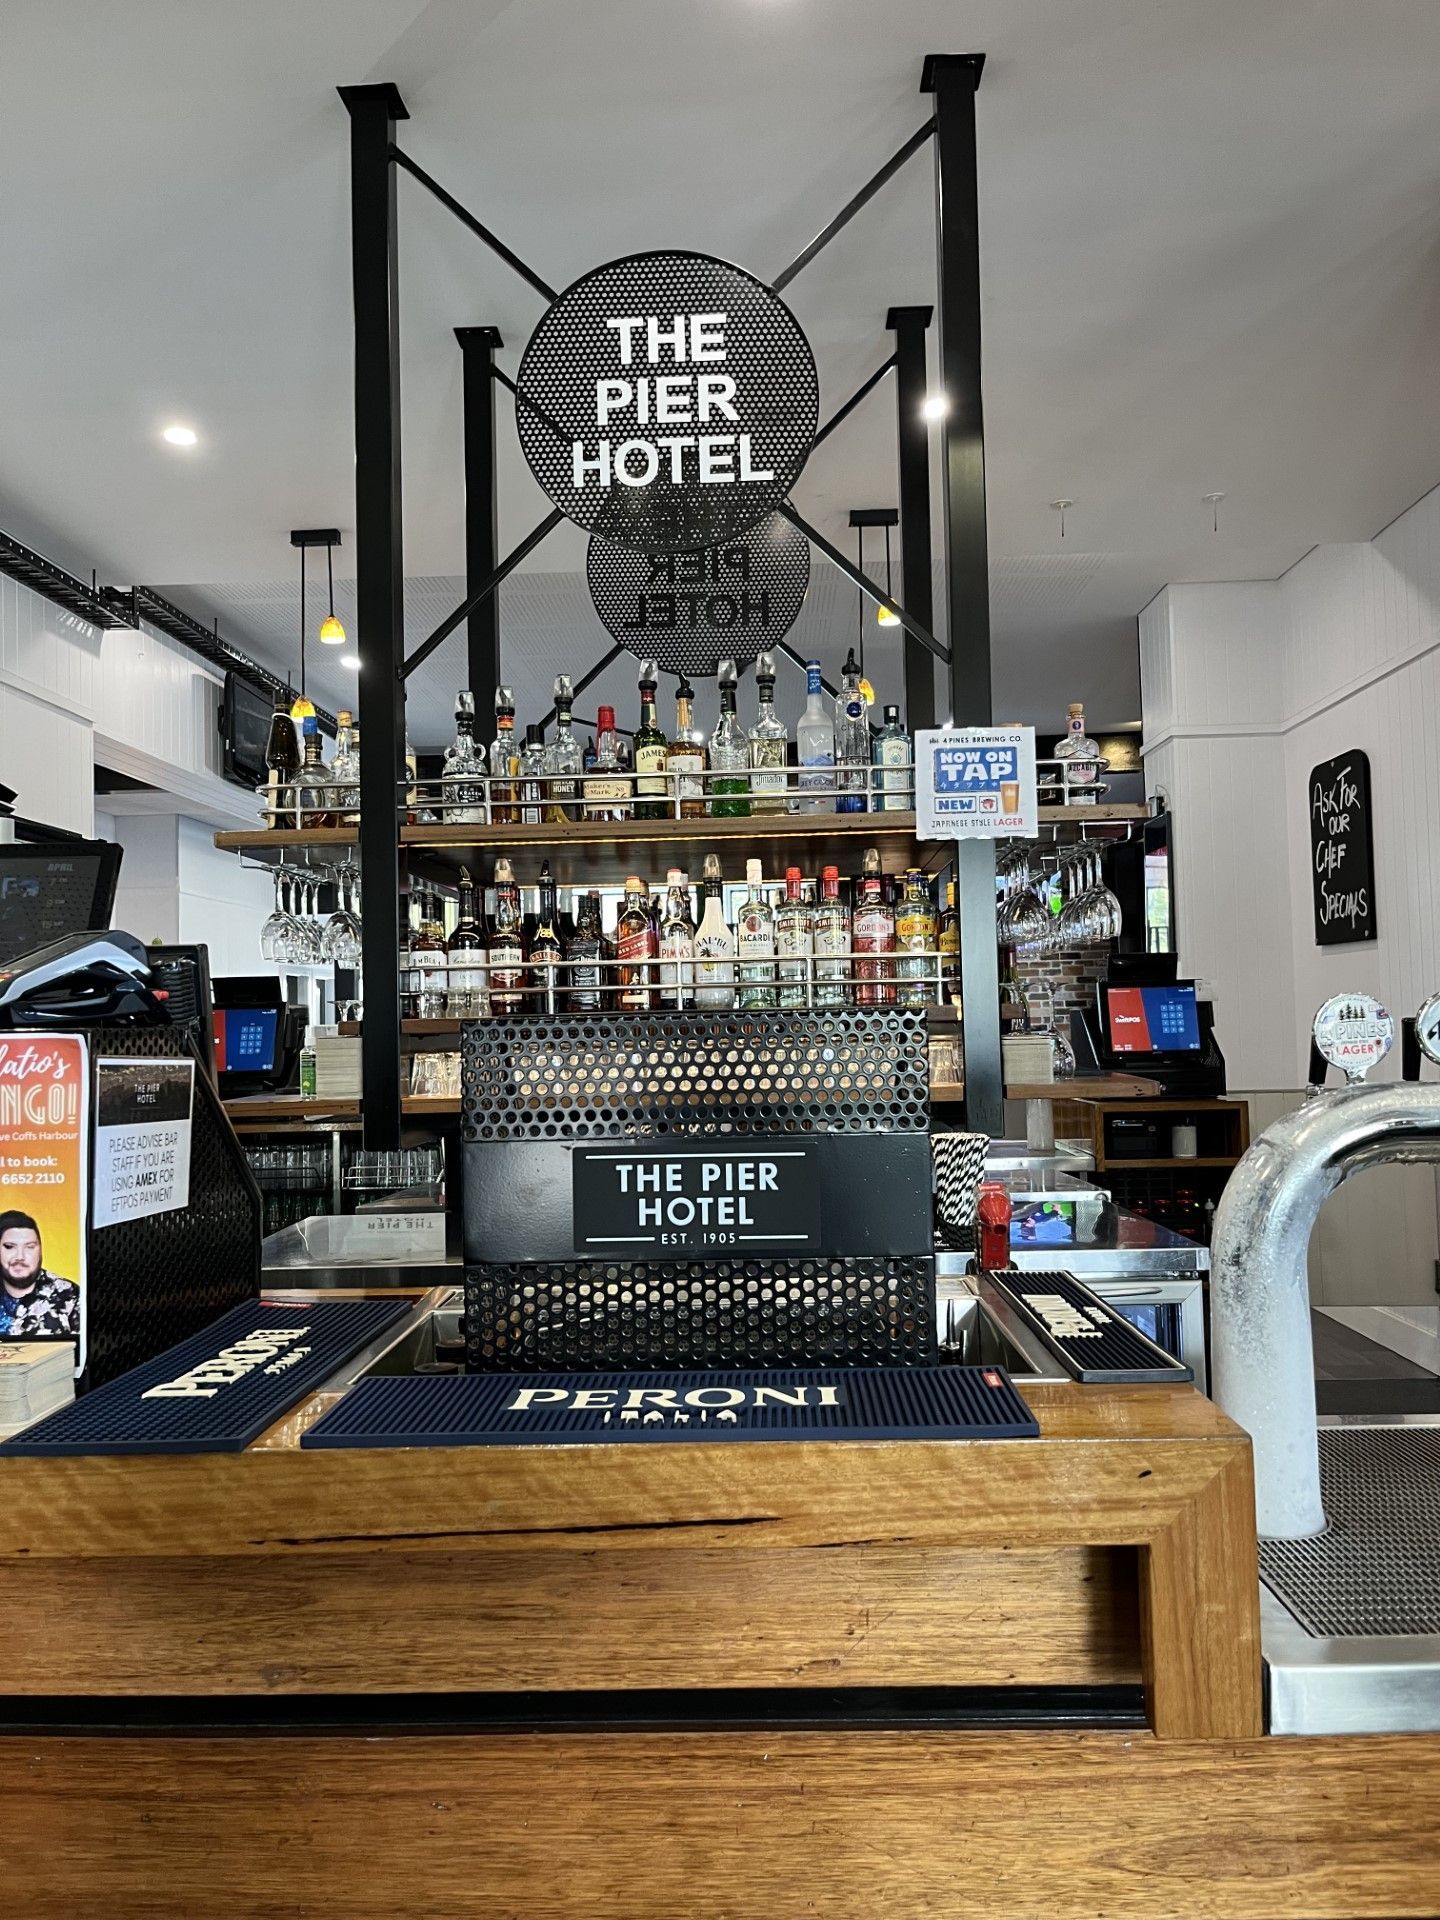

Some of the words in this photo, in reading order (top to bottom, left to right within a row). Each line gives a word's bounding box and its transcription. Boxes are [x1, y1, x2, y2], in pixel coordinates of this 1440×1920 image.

[606, 314, 727, 365] THE
[597, 375, 741, 425] PIER
[572, 433, 774, 488] HOTEL
[949, 736, 969, 744] PINES
[972, 735, 1006, 743] BREWING
[940, 751, 981, 764] NOW
[985, 750, 1013, 763] ON
[940, 763, 1013, 781] TAP
[553, 785, 575, 793] HONEY
[1312, 782, 1339, 828] ASK
[1336, 766, 1361, 811] FOR
[938, 799, 973, 811] NEW
[971, 818, 991, 827] STYLE
[993, 817, 1024, 827] LAGER
[1329, 814, 1350, 836] OUR
[1316, 840, 1347, 879] CHEF
[778, 919, 810, 928] SMIROFF
[1336, 1020, 1388, 1040] PINES
[12, 1131, 38, 1142] Coffs
[39, 1131, 79, 1141] Harbour
[109, 1136, 136, 1153] PLEASE
[136, 1133, 163, 1150] ADVISE
[164, 1131, 178, 1145] BAR
[8, 1157, 21, 1168] to
[23, 1156, 58, 1167] book:
[112, 1155, 134, 1173] STAFF
[134, 1154, 142, 1168] IF
[143, 1152, 160, 1168] YOU
[160, 1150, 175, 1165] ARE
[2, 1173, 33, 1185] 6652
[35, 1172, 65, 1184] 2110
[111, 1174, 134, 1193] USING
[135, 1171, 158, 1187] AMEX
[159, 1168, 175, 1184] FOR
[615, 1163, 683, 1193] THE
[701, 1162, 779, 1192] PIER
[111, 1193, 139, 1213] EFTPOS
[139, 1186, 173, 1207] PAYMENT
[638, 1196, 754, 1227] HOTEL
[661, 1233, 694, 1245] EST.
[703, 1232, 736, 1245] 1905
[508, 1386, 840, 1411] PERONI
